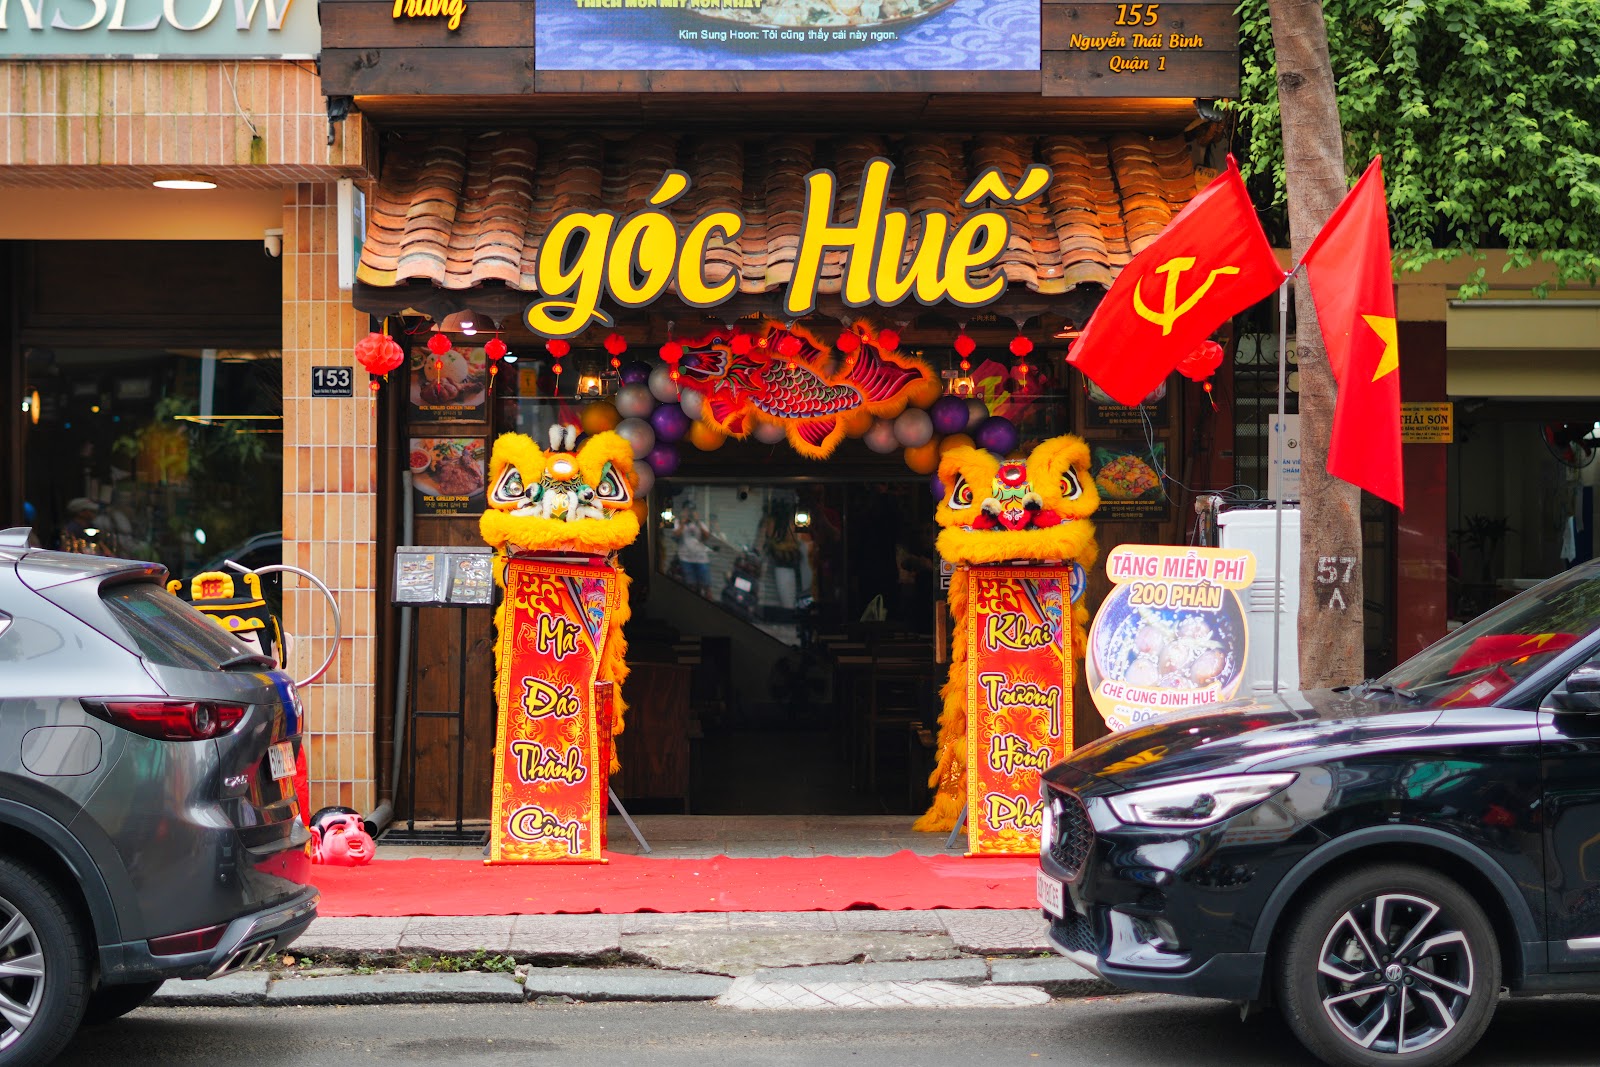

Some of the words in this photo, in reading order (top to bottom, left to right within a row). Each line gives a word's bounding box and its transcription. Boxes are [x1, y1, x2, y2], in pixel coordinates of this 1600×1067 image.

[1115, 4, 1159, 26] 155
[679, 30, 698, 40] Kim
[701, 30, 727, 42] Sung
[730, 30, 759, 40] Hoon:
[762, 29, 778, 40] Tôi
[781, 29, 805, 42] cũng
[808, 28, 829, 42] thấy
[832, 29, 847, 40] cái
[850, 29, 868, 42] này
[870, 31, 898, 42] ngon.
[1069, 31, 1126, 51] Nguyễn
[1132, 33, 1163, 48] Thái
[1169, 33, 1204, 48] Bình
[1109, 55, 1149, 73] Quận
[1157, 56, 1166, 71] 1
[524, 169, 745, 338] góc
[785, 157, 1052, 315] Huế
[315, 369, 350, 387] 153
[1427, 413, 1448, 425] SƠN
[1113, 553, 1158, 578] TẶNG
[1163, 552, 1208, 579] MIỄN
[1213, 557, 1247, 581] PHÍ
[1317, 556, 1357, 584] 57
[1131, 583, 1168, 605] 200
[1171, 580, 1222, 608] PHẦN
[1329, 587, 1347, 610] A
[539, 614, 581, 660] Mã
[986, 612, 1054, 651] Khai
[522, 676, 580, 718] Đáo
[1126, 689, 1157, 704] CUNG
[511, 740, 586, 785] Thành
[990, 734, 1050, 775] Hồng
[986, 793, 1043, 831] Phá
[509, 806, 580, 855] Công
